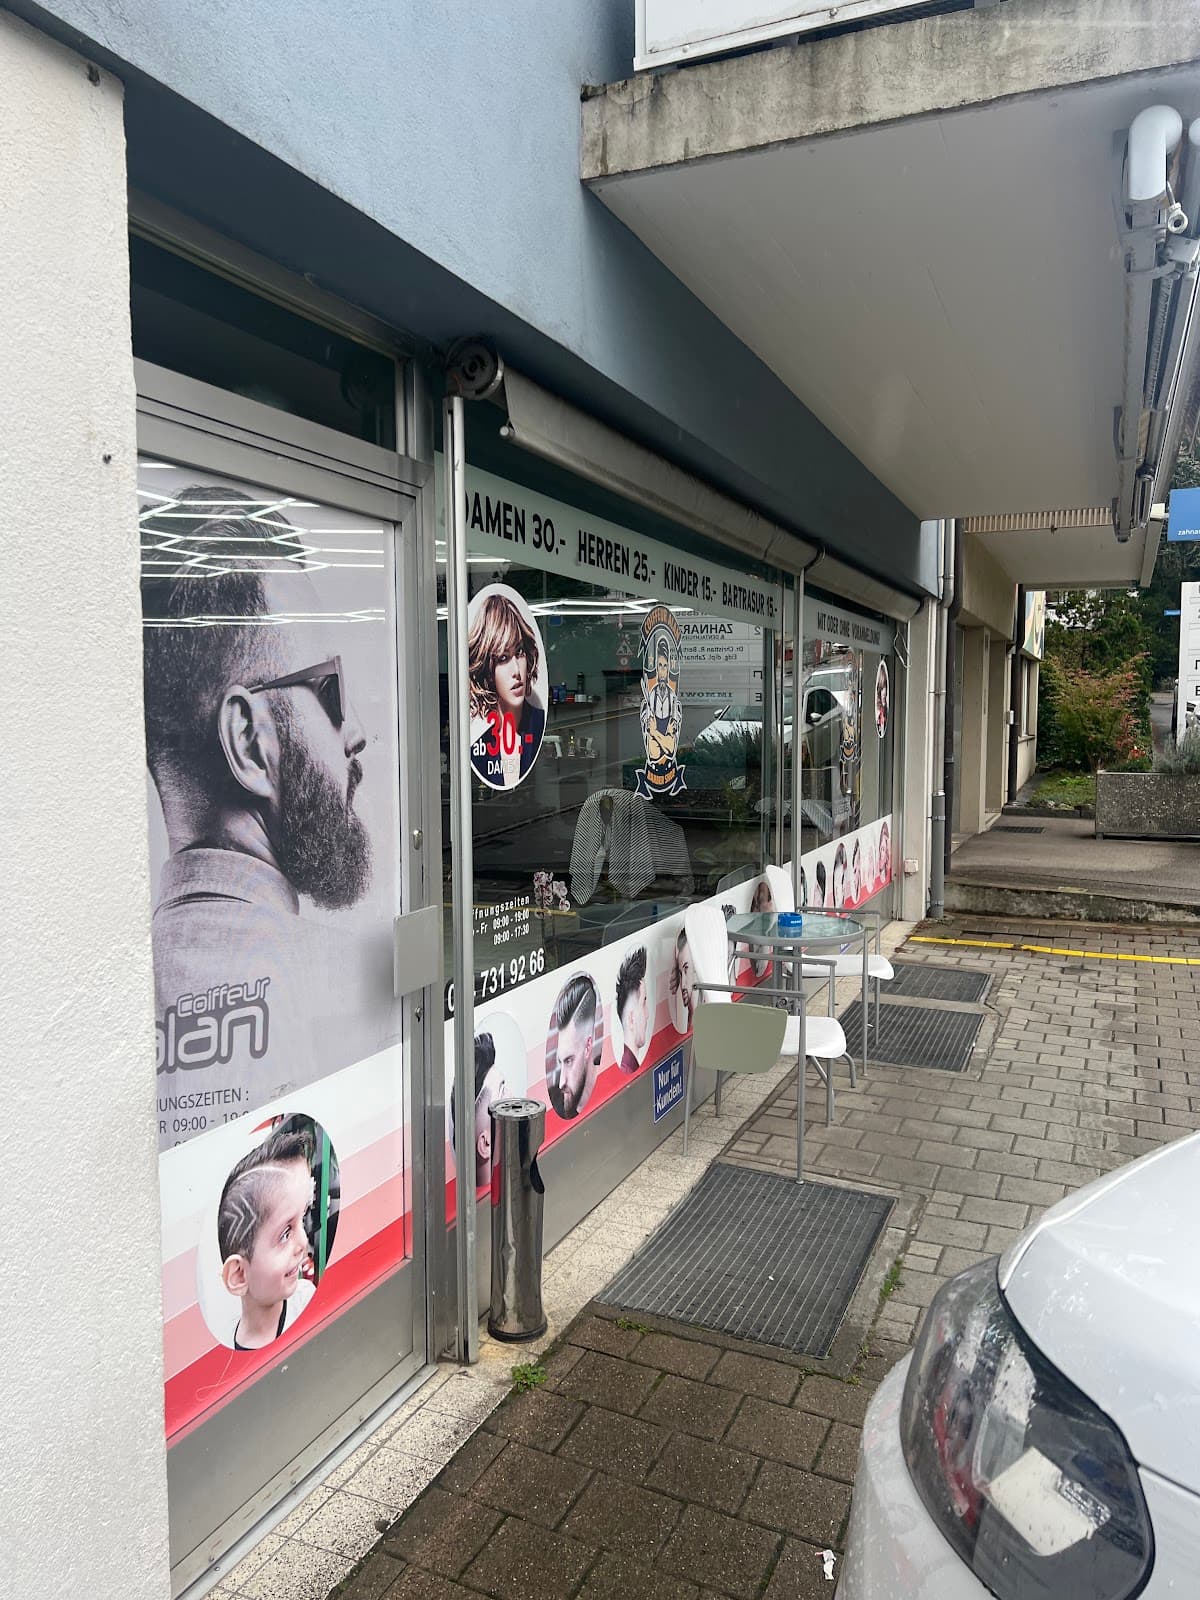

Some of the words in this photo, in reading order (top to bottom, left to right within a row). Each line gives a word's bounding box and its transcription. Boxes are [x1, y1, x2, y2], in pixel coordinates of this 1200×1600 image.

[532, 513, 566, 555] 30.-
[578, 530, 630, 576] HERREN
[633, 550, 656, 584] 25.-
[664, 561, 699, 599] KINDER
[702, 575, 717, 602] 15.-
[722, 581, 765, 617] BARTRASUR
[472, 738, 487, 756] ab
[480, 962, 505, 998] 731
[509, 955, 526, 985] 92
[529, 947, 545, 976] 66
[658, 1069, 671, 1090] Nur
[157, 1087, 242, 1113] UNGSZEITEN
[656, 1075, 683, 1114] Kunden!
[172, 1115, 207, 1133] 09:00
